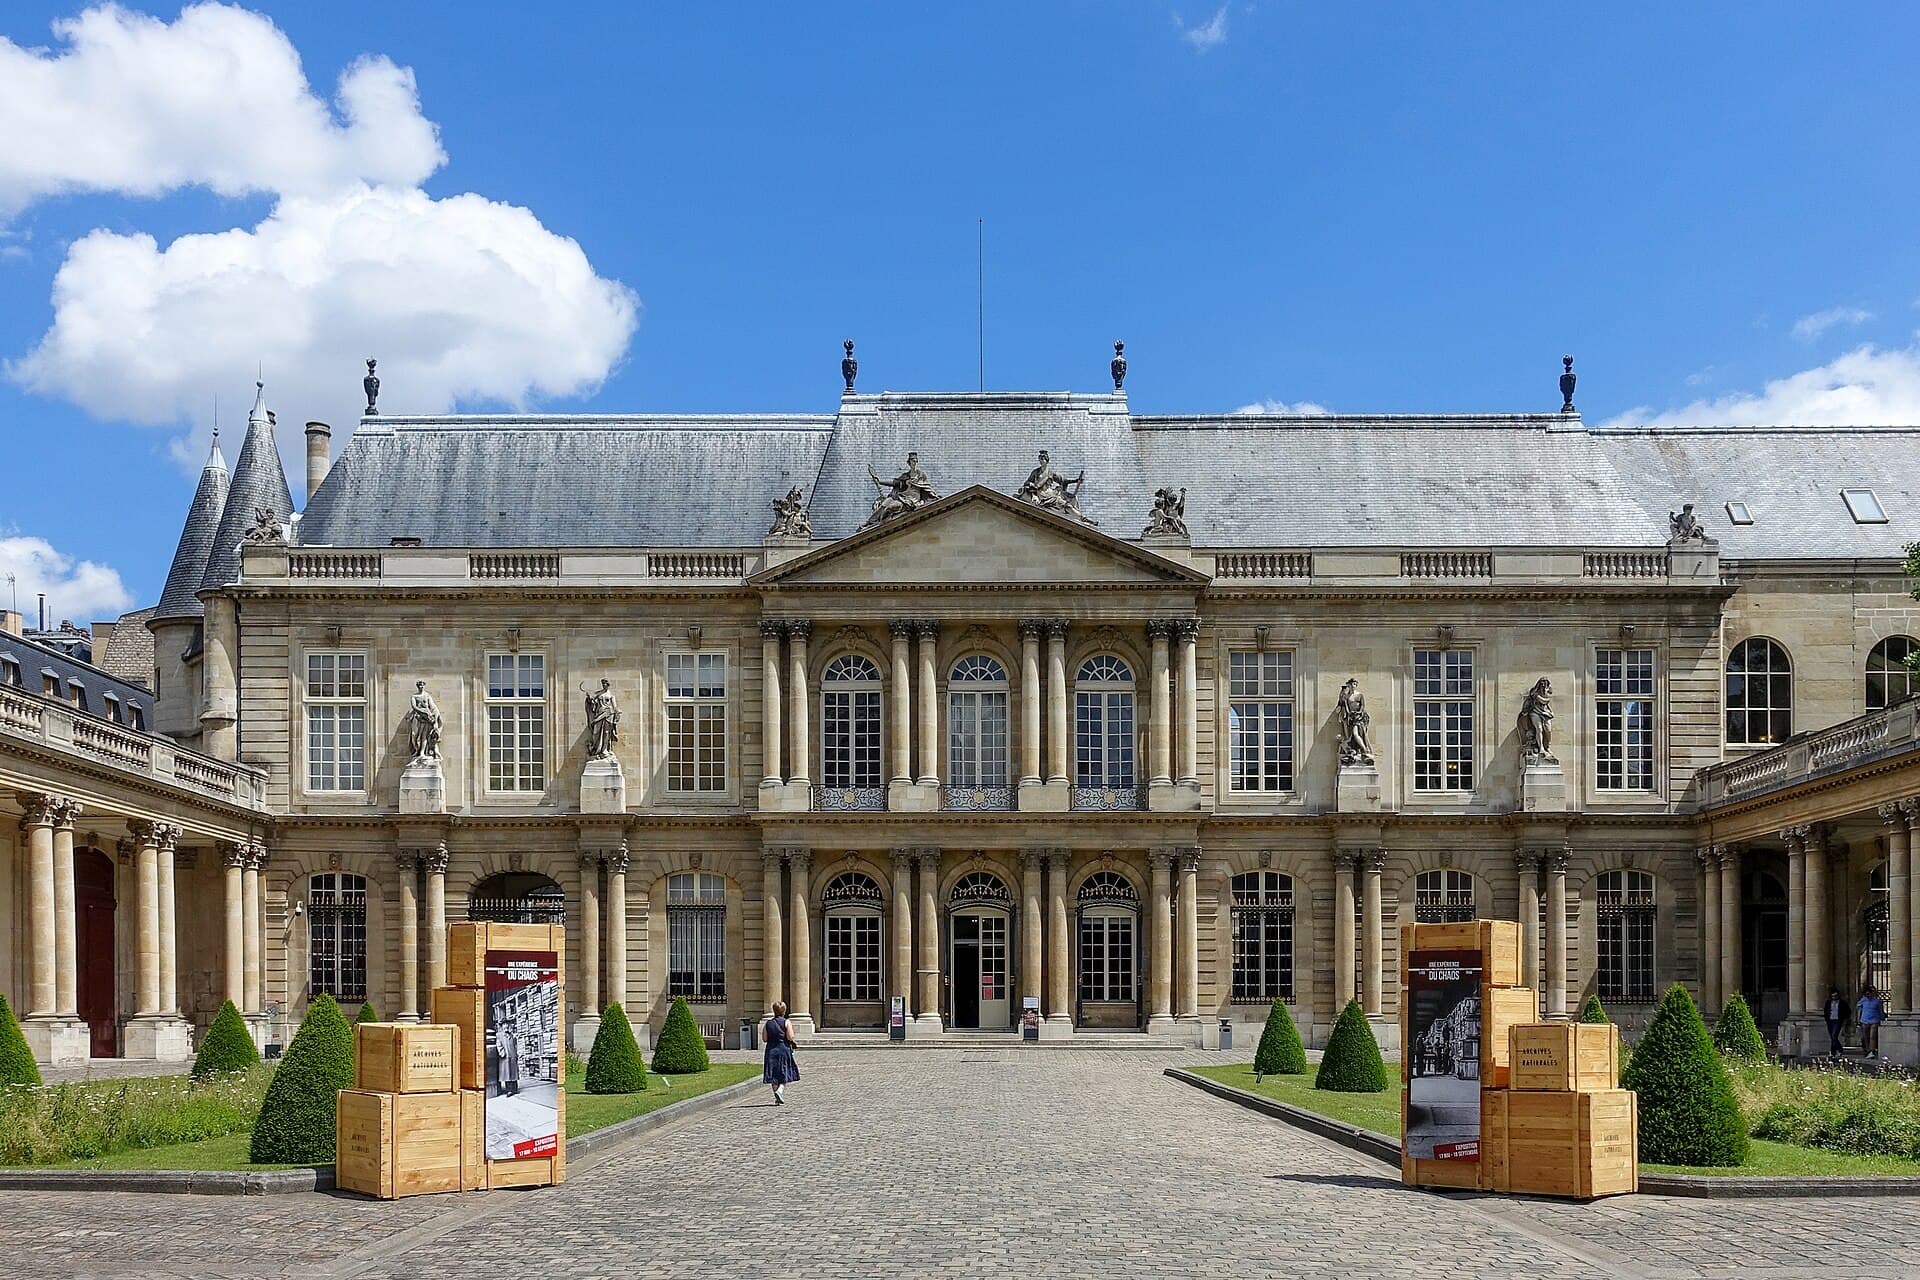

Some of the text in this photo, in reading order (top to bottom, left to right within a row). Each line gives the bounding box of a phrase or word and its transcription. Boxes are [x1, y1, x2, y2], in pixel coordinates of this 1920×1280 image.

[508, 970, 517, 980] DU
[518, 970, 538, 980] CHAOS
[1429, 970, 1437, 980] DU
[1439, 970, 1459, 980] CHAOS
